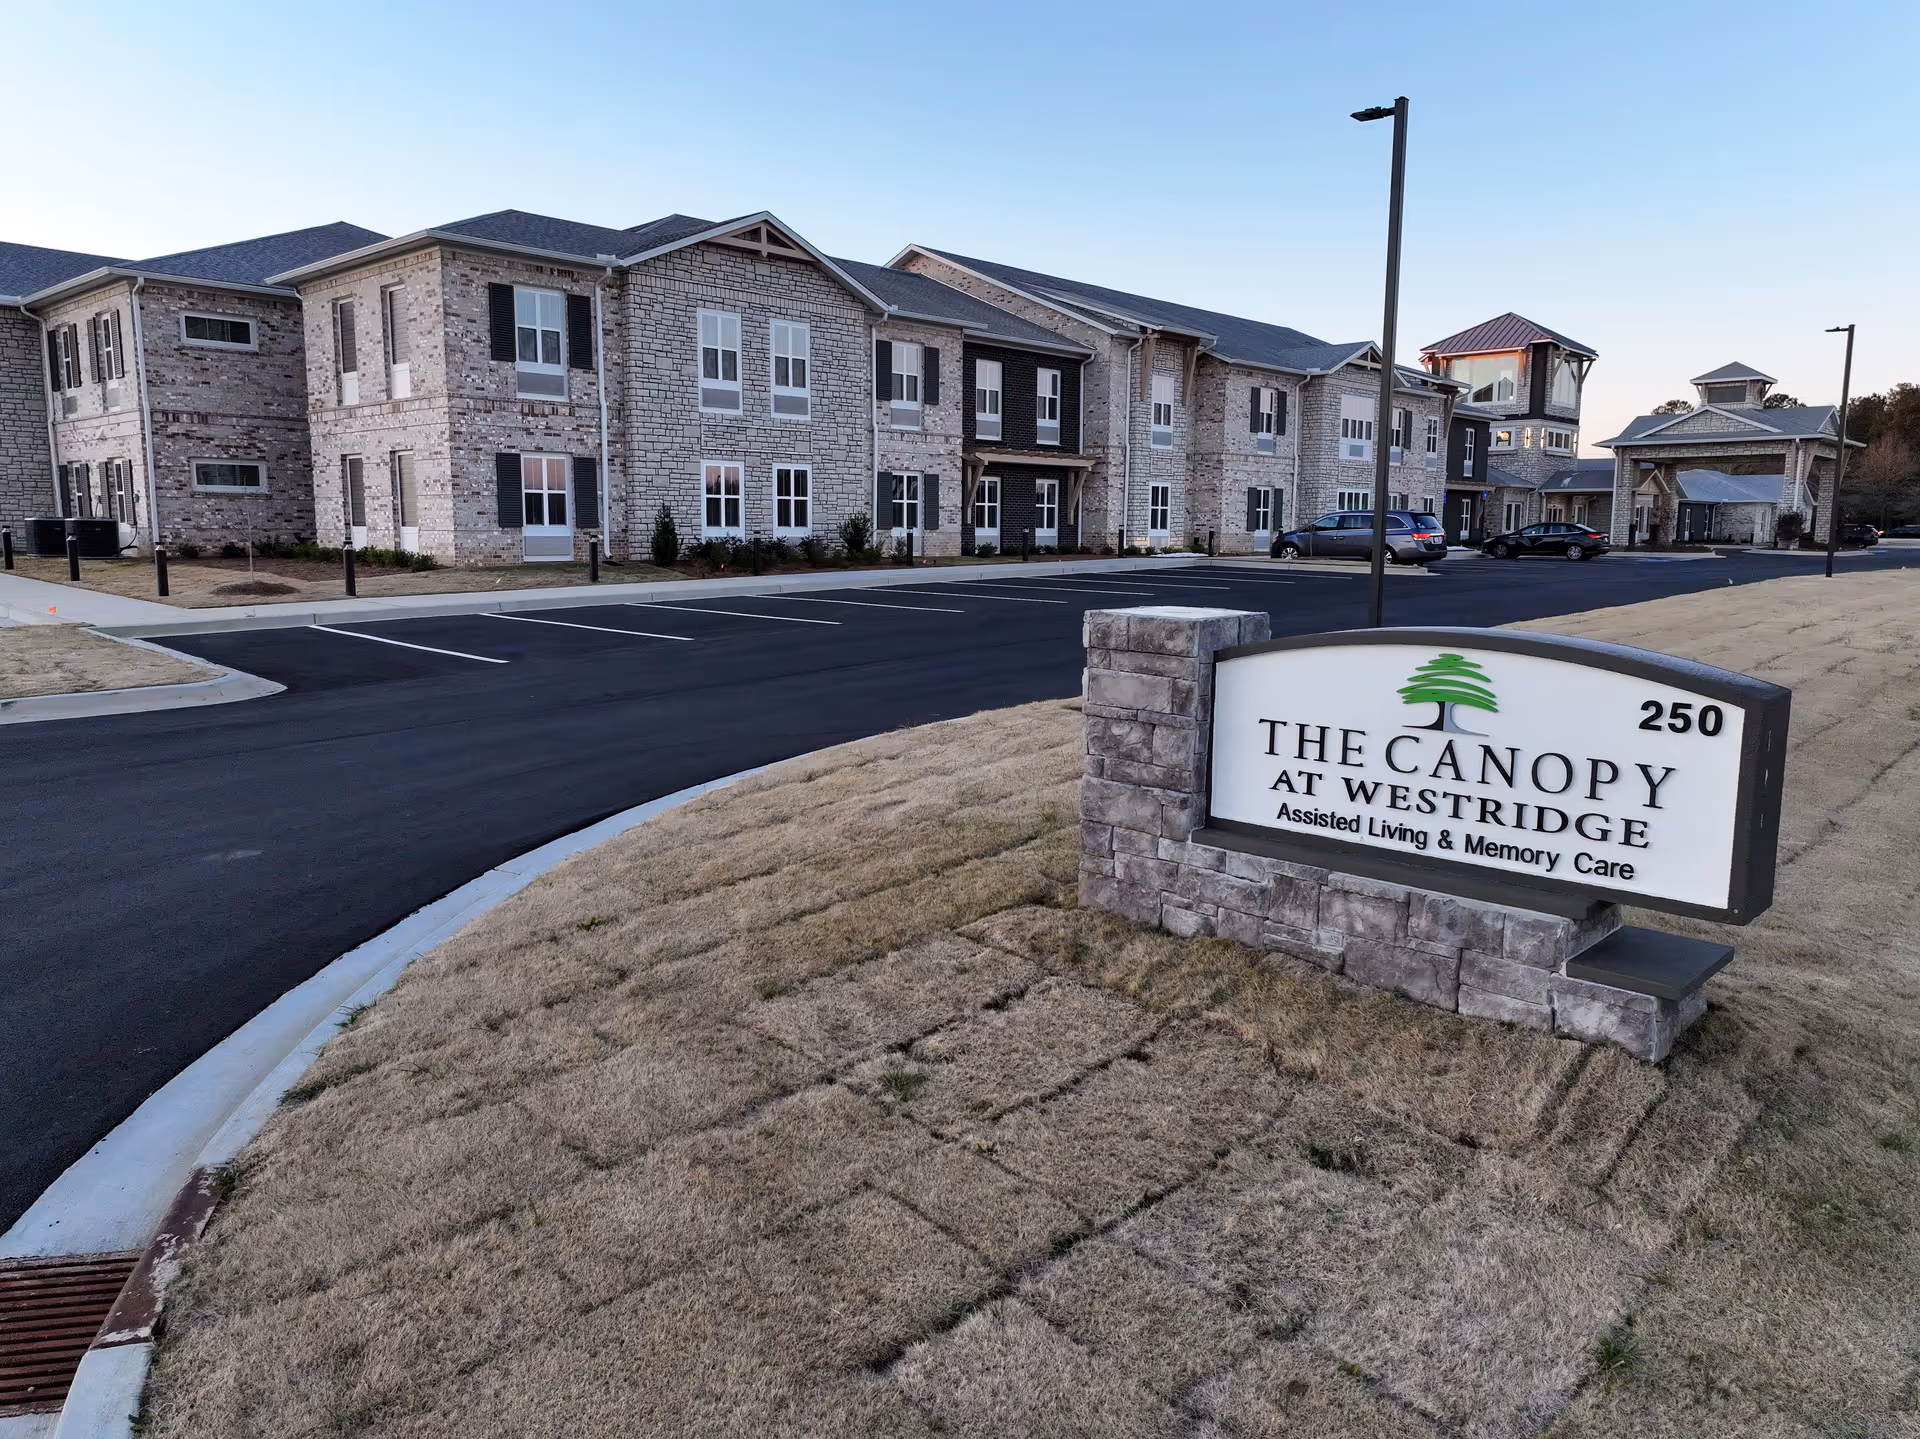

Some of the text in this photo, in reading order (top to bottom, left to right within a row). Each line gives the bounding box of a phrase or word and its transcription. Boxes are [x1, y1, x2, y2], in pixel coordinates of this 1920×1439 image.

[1638, 699, 1724, 737] 250
[1258, 718, 1677, 810] THE CANOPY
[1269, 769, 1650, 849] AT WESTRIDGE
[1276, 802, 1635, 881] Assisted Living & Memory Care
